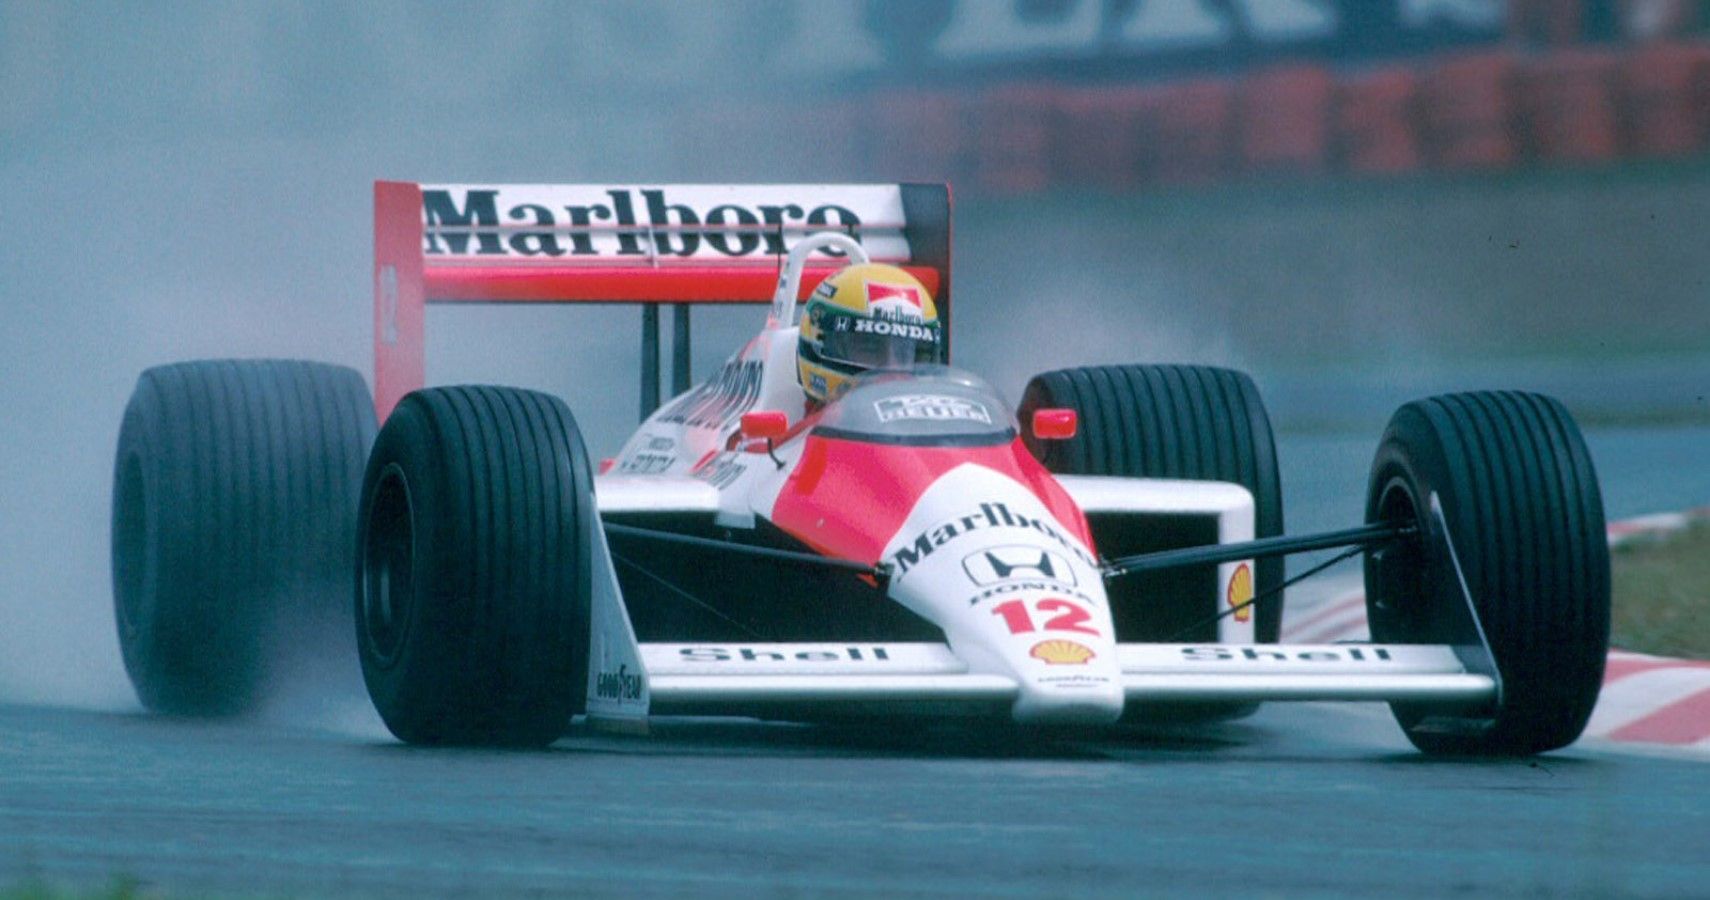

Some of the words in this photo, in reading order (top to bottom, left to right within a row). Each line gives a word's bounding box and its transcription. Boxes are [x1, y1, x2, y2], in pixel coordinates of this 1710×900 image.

[422, 189, 862, 257] Marlboro
[855, 320, 934, 342] HONDA
[991, 597, 1100, 637] 12
[678, 647, 889, 662] Shell
[1181, 647, 1391, 661] Shell
